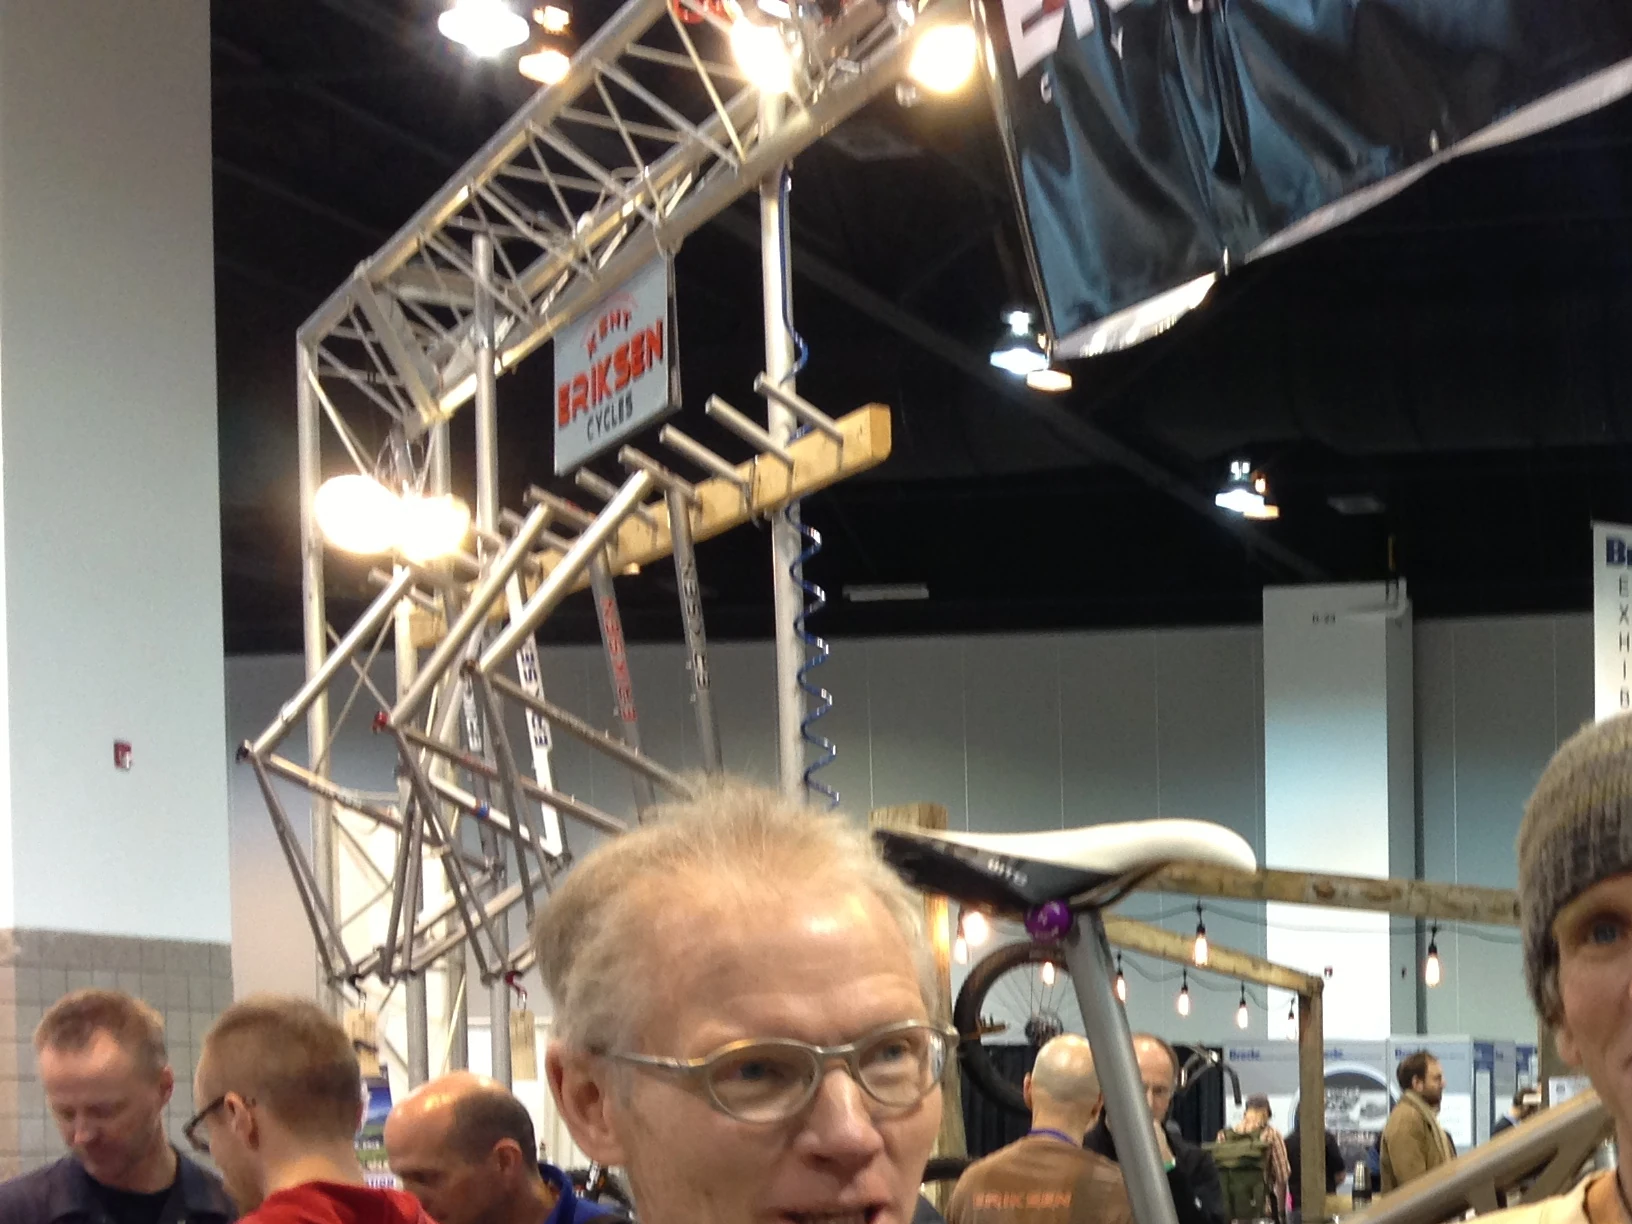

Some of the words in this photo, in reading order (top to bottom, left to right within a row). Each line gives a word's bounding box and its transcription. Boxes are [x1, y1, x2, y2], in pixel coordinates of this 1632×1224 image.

[586, 308, 632, 360] KENT
[557, 318, 664, 428] ERIKSEN
[586, 391, 633, 441] CYCLES
[972, 1190, 1073, 1210] ERIKSEN
